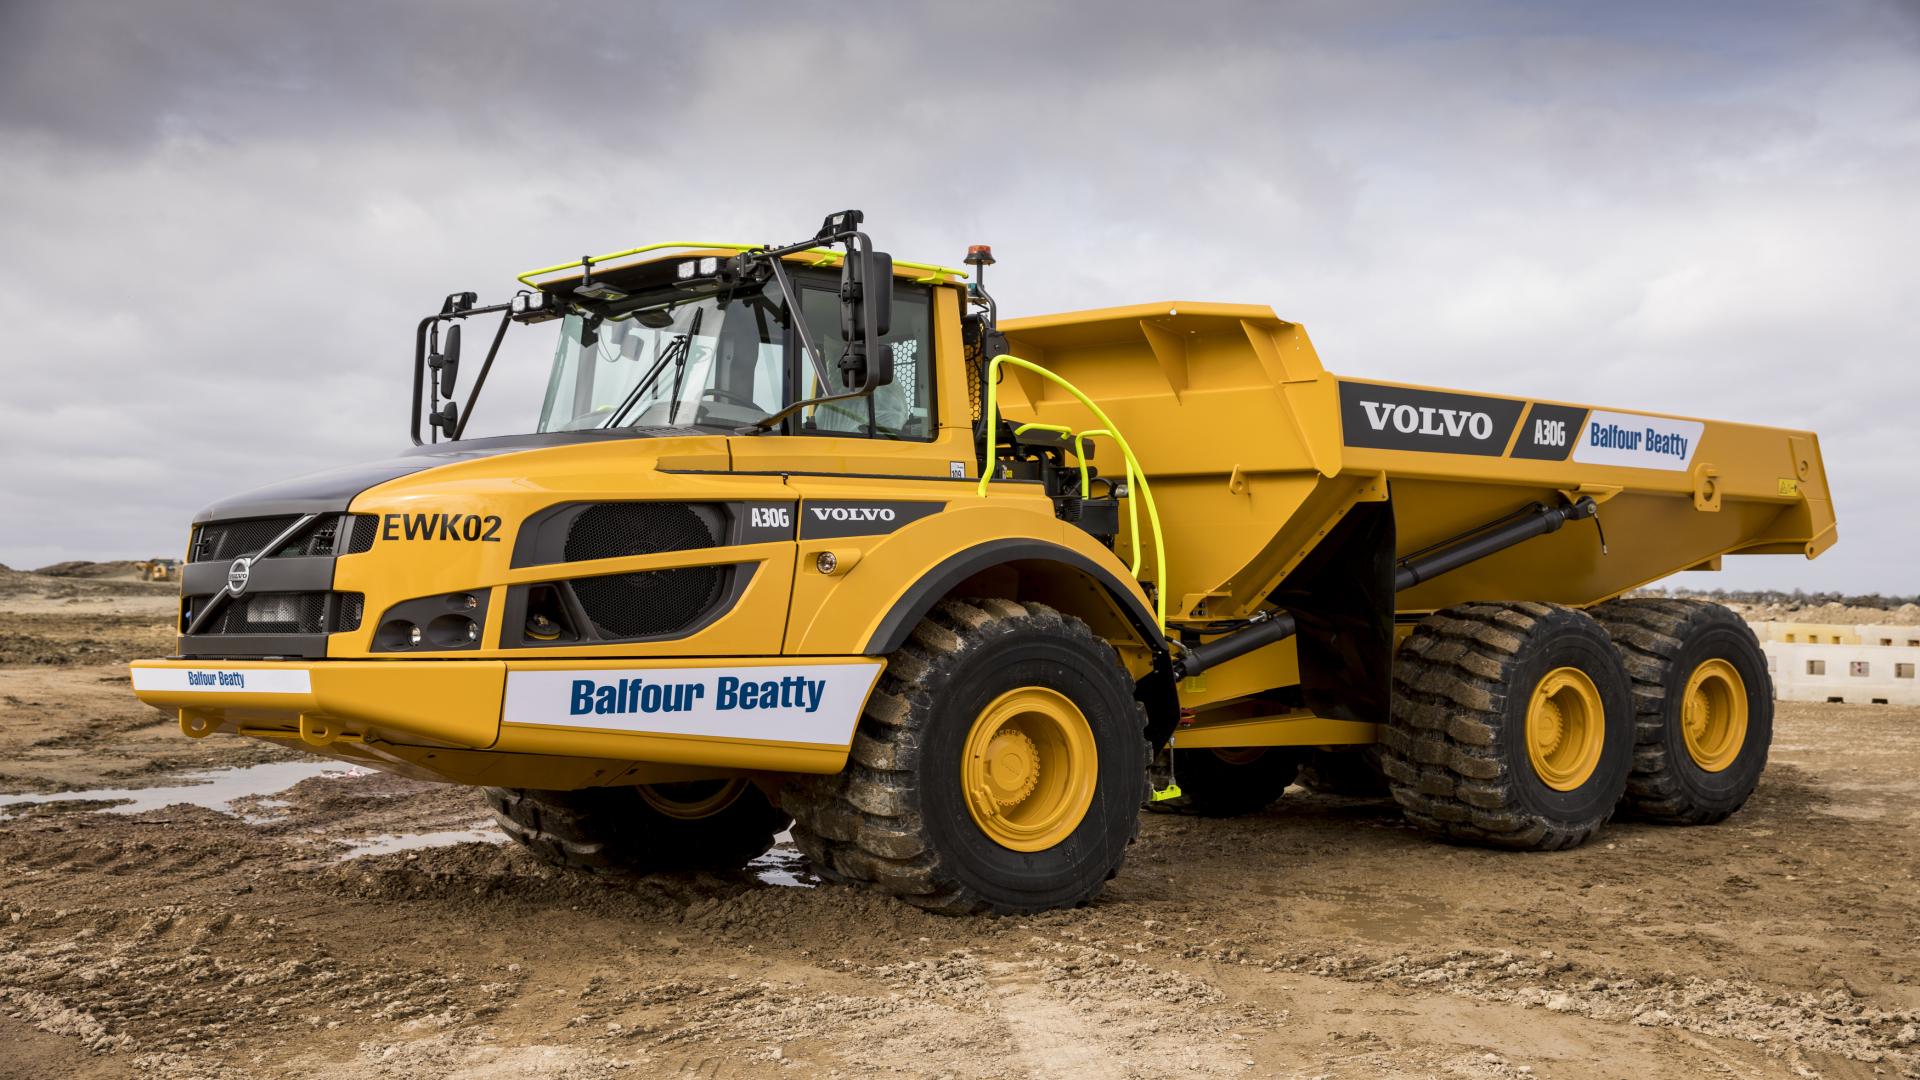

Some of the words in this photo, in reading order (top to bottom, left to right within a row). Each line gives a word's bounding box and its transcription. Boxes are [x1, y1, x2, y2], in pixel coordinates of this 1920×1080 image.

[1359, 400, 1493, 440] VOLVO
[1534, 418, 1566, 447] A30G
[1590, 422, 1642, 450] Balfour
[1645, 428, 1688, 460] Beatty
[382, 513, 502, 542] EWK02
[751, 507, 790, 528] A30G
[811, 507, 896, 521] VOLVO
[188, 671, 217, 686] Balfour
[218, 671, 245, 688] Beatty
[570, 678, 705, 715] Balfour
[716, 676, 826, 712] Beatty
